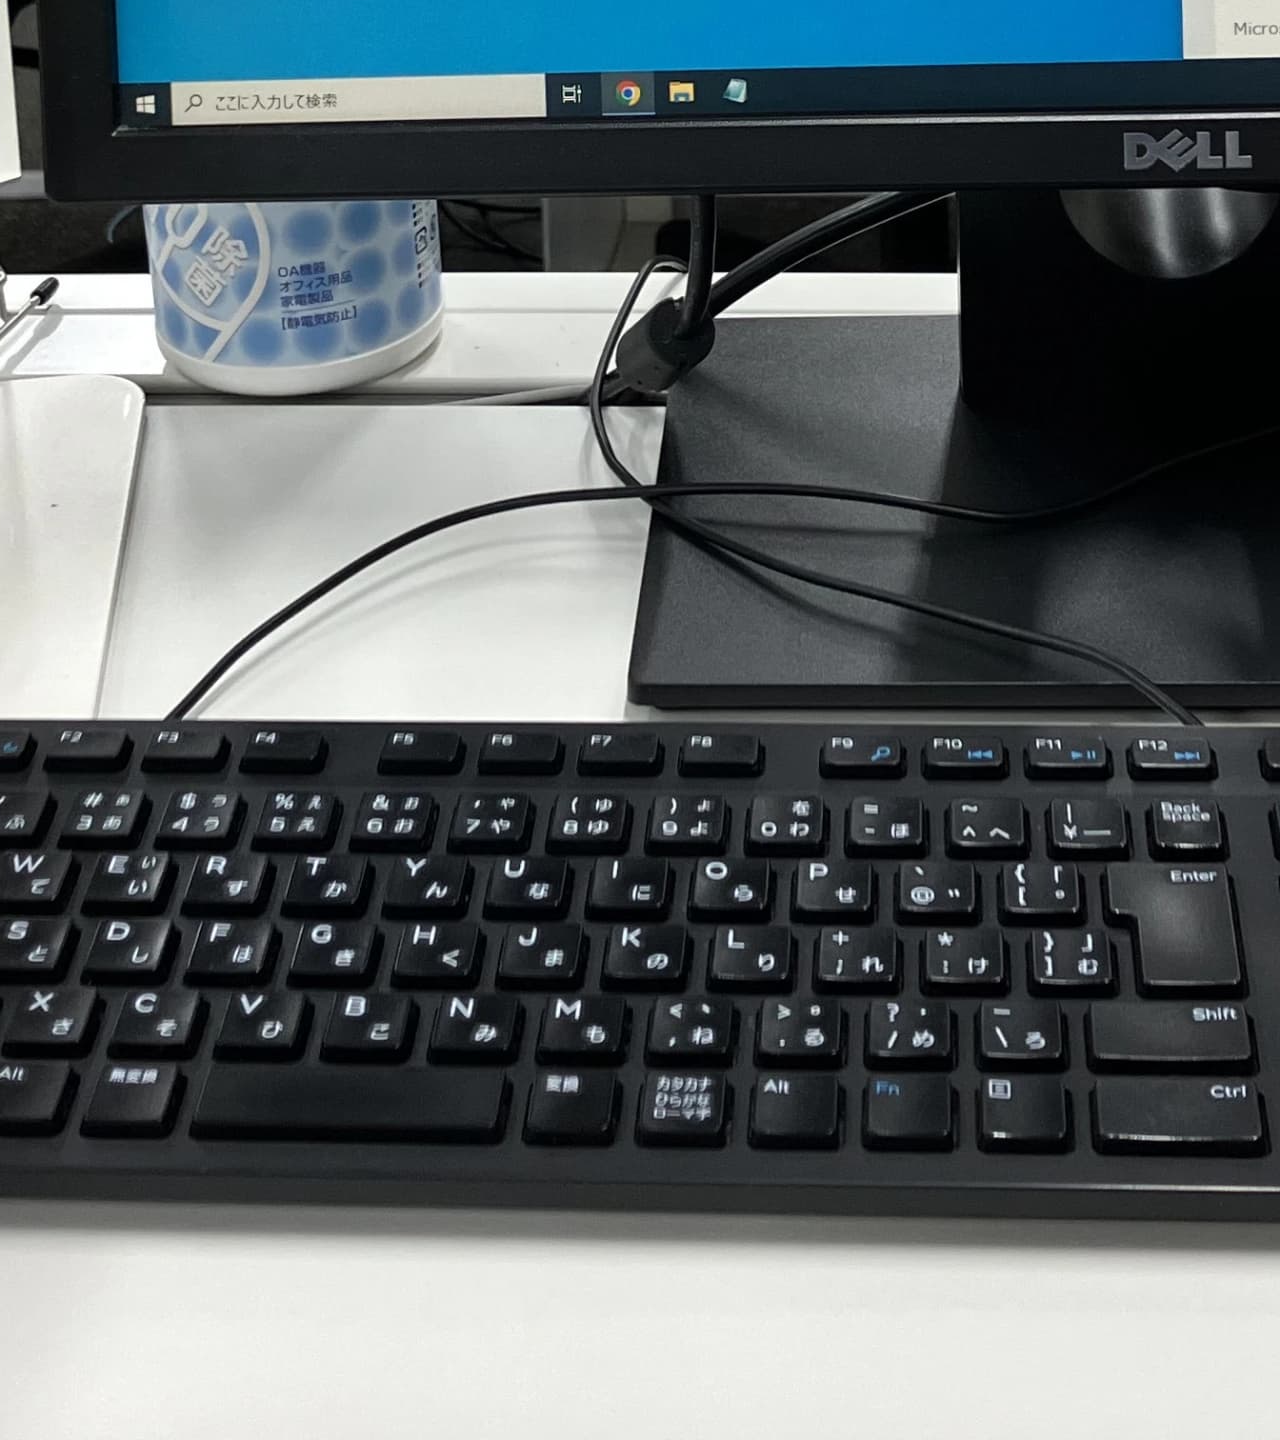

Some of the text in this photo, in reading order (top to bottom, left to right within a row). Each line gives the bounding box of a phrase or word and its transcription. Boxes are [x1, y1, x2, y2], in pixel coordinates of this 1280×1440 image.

[214, 92, 338, 110] ここに入力して検索
[1123, 128, 1253, 173] DELL
[278, 261, 326, 278] OA機器
[279, 270, 353, 293] オフィス用品
[280, 291, 334, 308] 家電製品
[256, 732, 277, 744] F4
[591, 734, 612, 747] F7
[832, 736, 853, 749] F9
[933, 737, 963, 750] F10
[1138, 738, 1168, 752] F12
[1161, 801, 1201, 814] Back
[12, 854, 45, 873] W
[107, 855, 130, 874] E
[205, 856, 227, 875] R
[704, 861, 728, 880] O
[809, 863, 829, 881] P
[1170, 869, 1218, 883] Enter
[7, 920, 30, 940] S
[105, 921, 131, 940] D
[727, 928, 745, 949] L
[554, 998, 583, 1020] M
[1192, 1007, 1238, 1022] Shift
[763, 1078, 790, 1096] Alt
[876, 1080, 901, 1097] Fn
[1210, 1084, 1247, 1100] Ctrl
